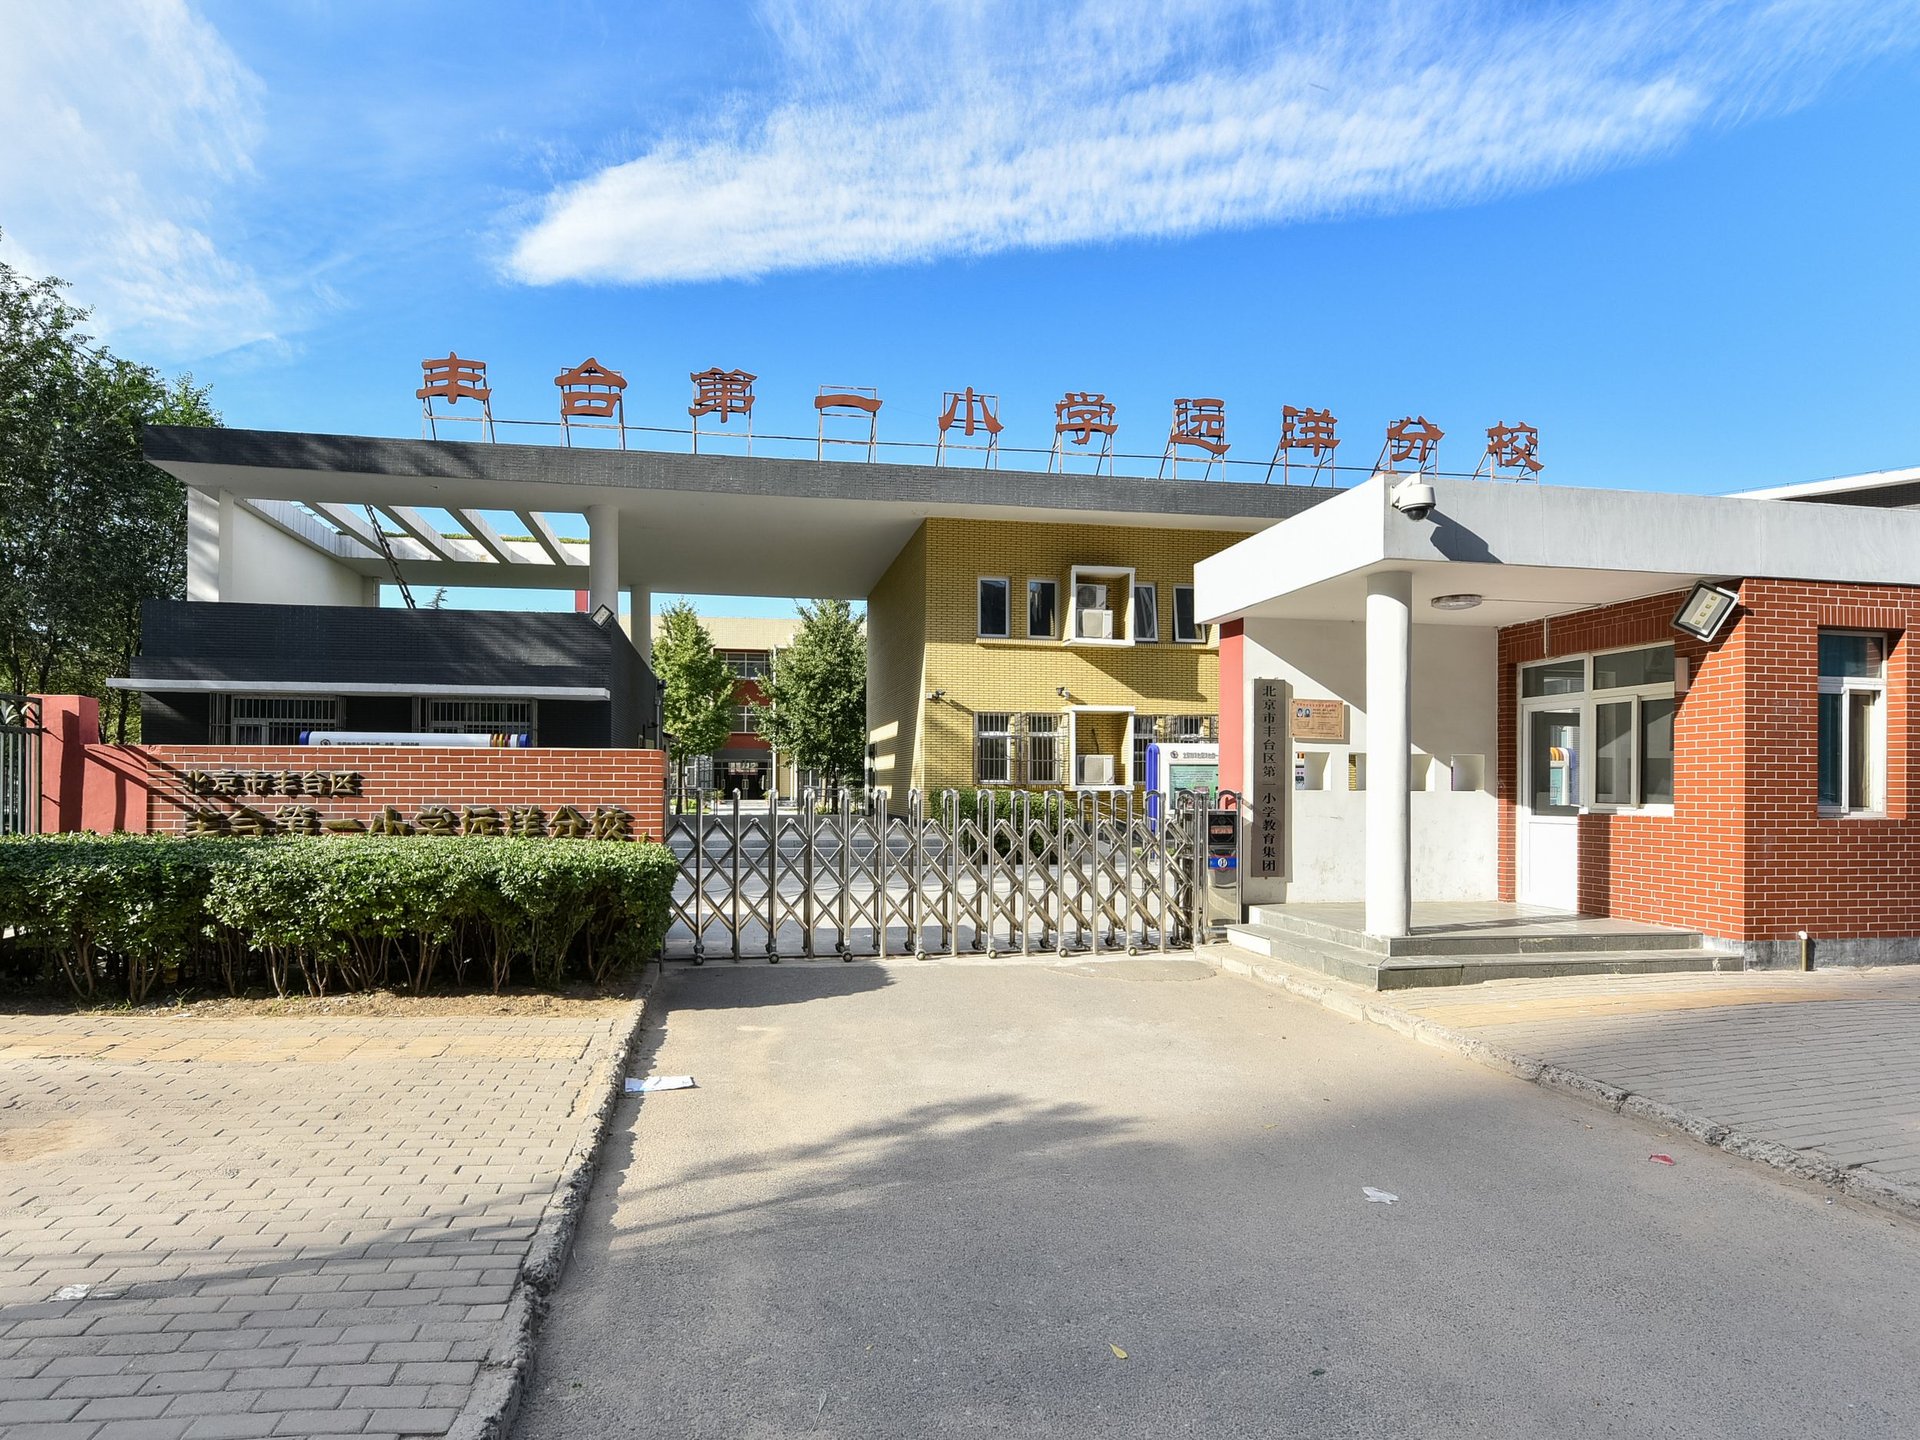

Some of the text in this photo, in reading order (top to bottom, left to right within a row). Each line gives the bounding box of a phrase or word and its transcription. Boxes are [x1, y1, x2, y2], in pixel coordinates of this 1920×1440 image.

[416, 351, 1544, 472] 丰台第一小学远洋分校
[184, 769, 359, 796] 北京市丰台区
[1261, 685, 1277, 872] 北京市丰台区第一小学教育集团
[184, 804, 632, 841] 丰台第一小学远洋分校
